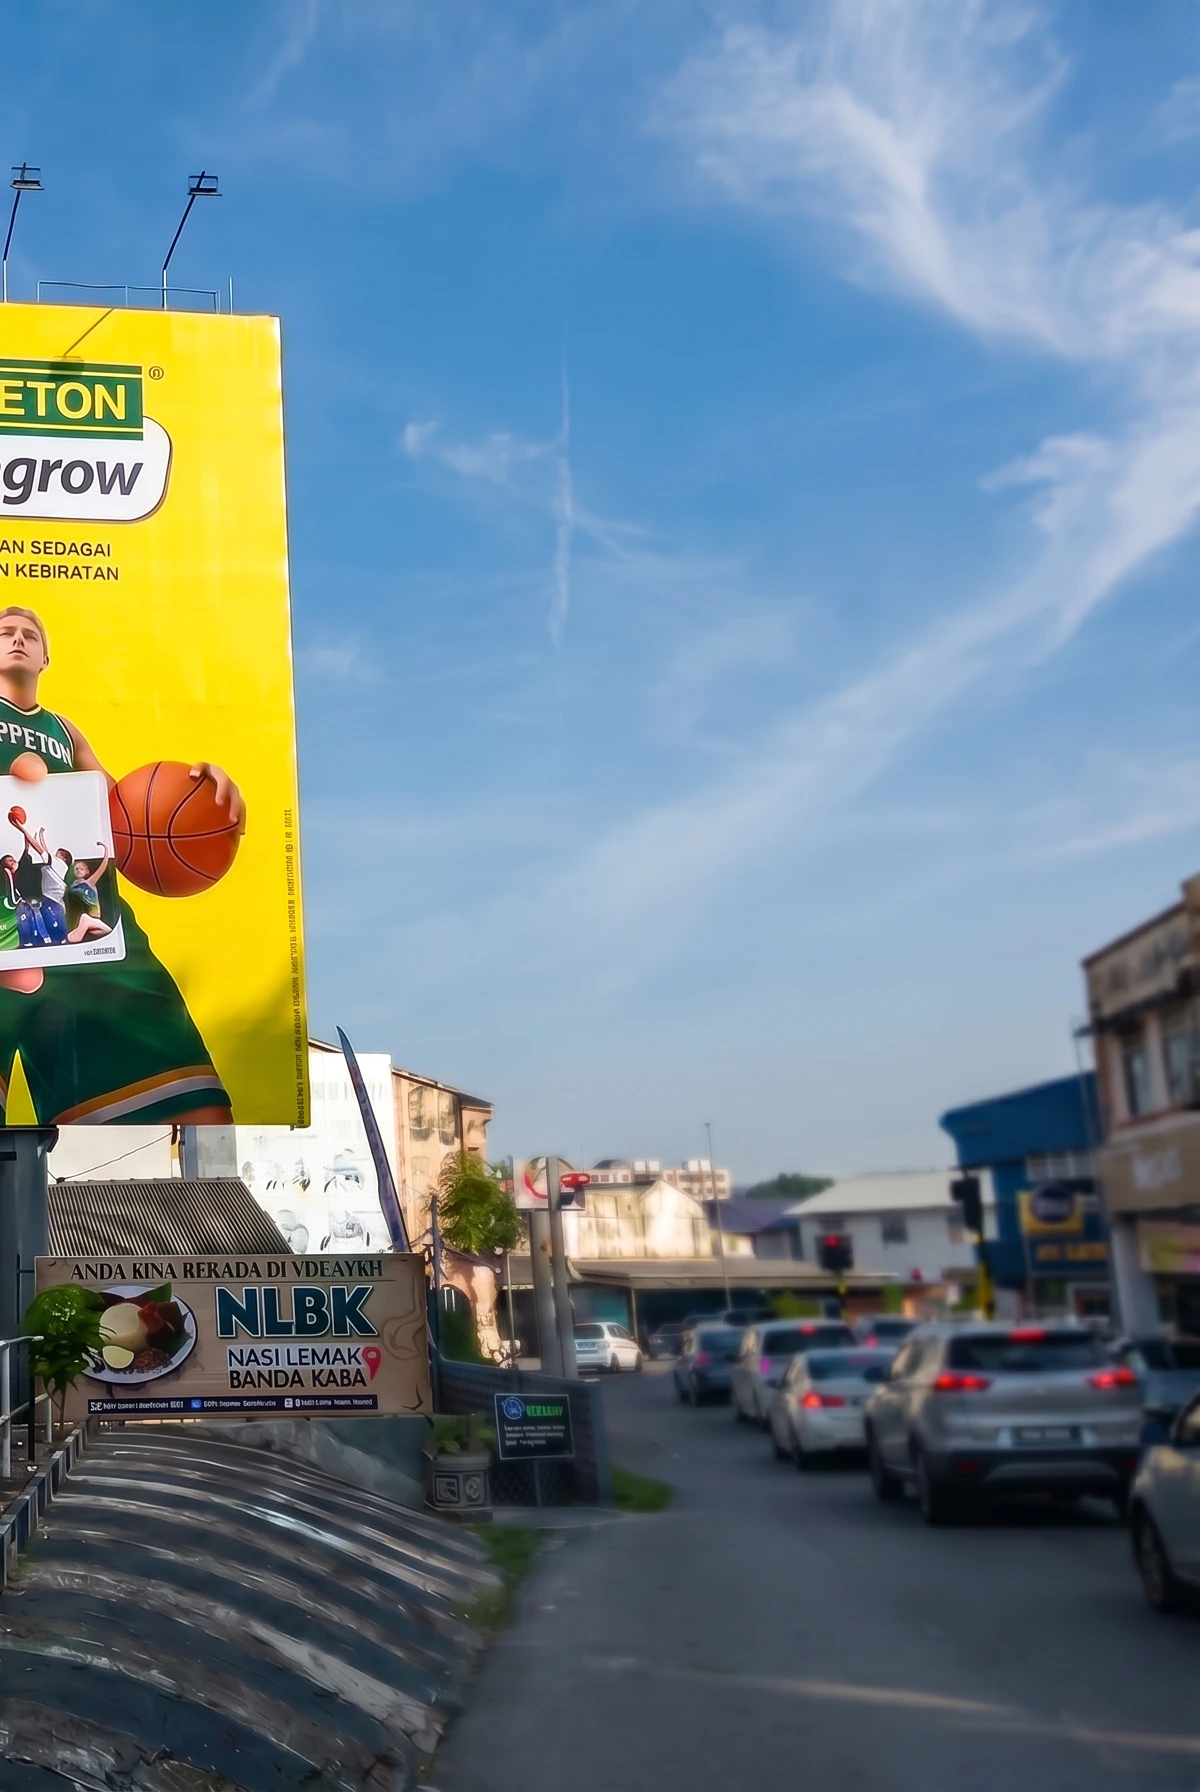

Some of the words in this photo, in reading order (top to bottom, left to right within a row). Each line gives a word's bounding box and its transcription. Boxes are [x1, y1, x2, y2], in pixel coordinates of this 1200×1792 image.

[30, 540, 111, 557] SEDAGAI
[15, 563, 119, 580] KEBIRATAN
[70, 1263, 127, 1280] ANDA
[266, 1261, 287, 1278] DI
[215, 1285, 379, 1338] NLBK
[228, 1348, 280, 1367] NASI
[286, 1347, 363, 1366] LEMAK
[229, 1370, 305, 1389] BANDA
[311, 1368, 368, 1388] KABA
